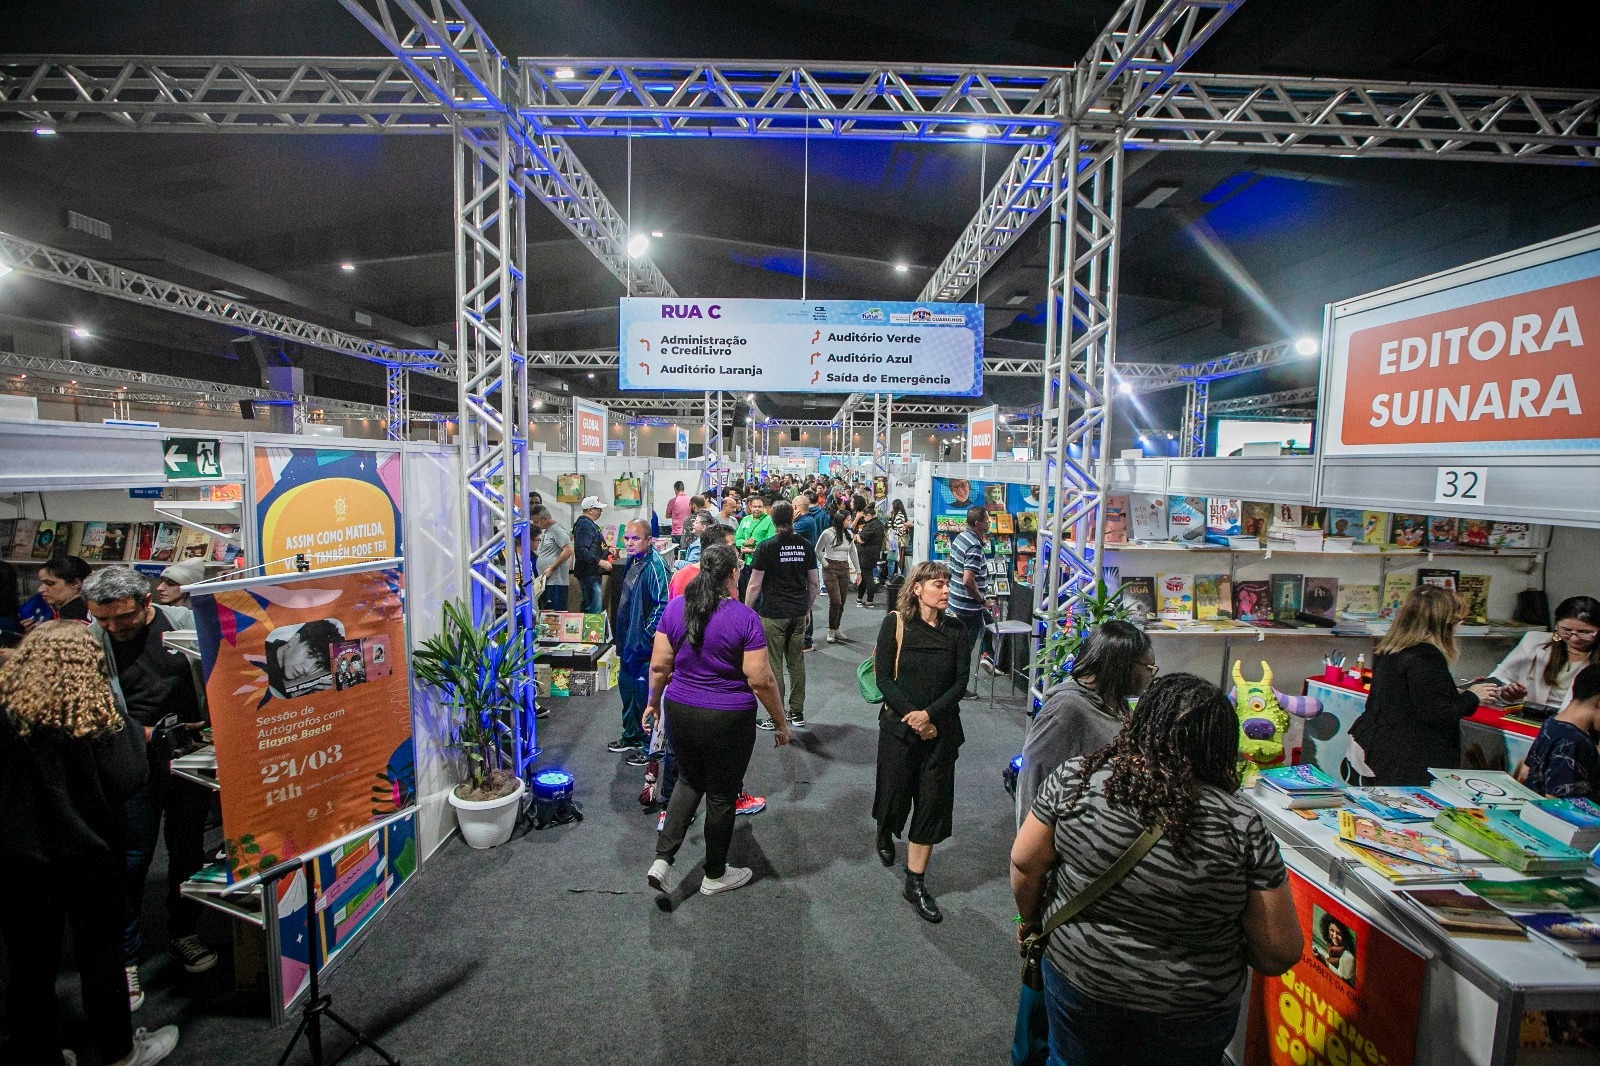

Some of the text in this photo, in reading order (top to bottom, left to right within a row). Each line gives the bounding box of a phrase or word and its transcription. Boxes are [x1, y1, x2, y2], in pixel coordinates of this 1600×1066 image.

[661, 304, 722, 319] RUA C
[660, 335, 747, 347] Administração
[827, 332, 921, 344] Auditório Verde
[1379, 305, 1584, 375] EDITORA
[660, 346, 732, 356] e CrediLivro
[827, 352, 913, 364] Auditório Azul
[660, 364, 763, 377] Auditório Laranja
[826, 372, 951, 387] Saída de Emergência
[1369, 373, 1582, 428] SUINARA
[582, 417, 600, 431] GLOBAL
[582, 434, 600, 447] EDITORA
[1442, 470, 1479, 499] 32
[1209, 504, 1228, 515] BUR
[1172, 515, 1191, 523] NINO
[285, 521, 385, 550] ASSIM COMO MATILDA,
[315, 544, 350, 564] TAMBÉM
[351, 544, 372, 557] PODE
[374, 540, 387, 552] TER
[256, 705, 315, 727] Sessão de
[257, 708, 345, 739] Autógrafos com
[258, 723, 332, 750] Elayne Baeta
